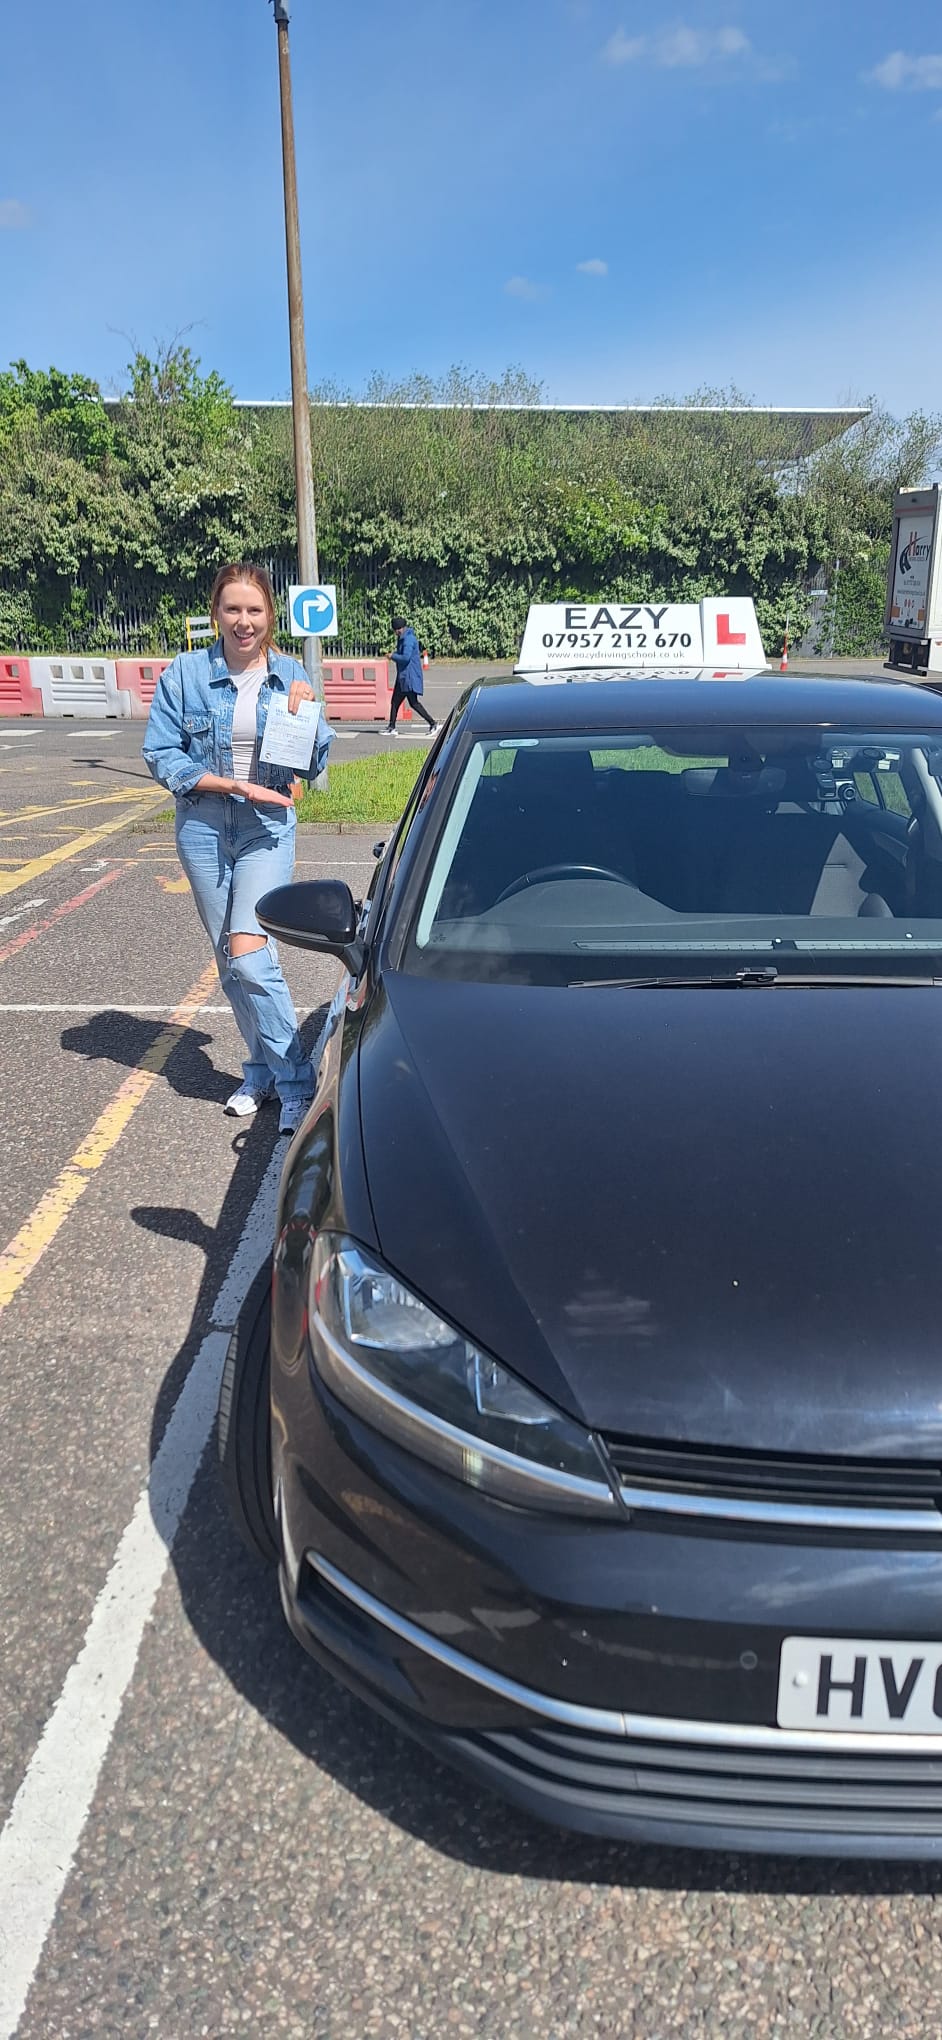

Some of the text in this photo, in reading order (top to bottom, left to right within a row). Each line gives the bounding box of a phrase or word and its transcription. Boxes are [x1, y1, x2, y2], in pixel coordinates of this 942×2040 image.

[564, 607, 669, 630] EAZY
[716, 614, 746, 645] L
[542, 633, 692, 648] 07957 212 670
[547, 650, 685, 660] www.eazydrivingschool.co.uk
